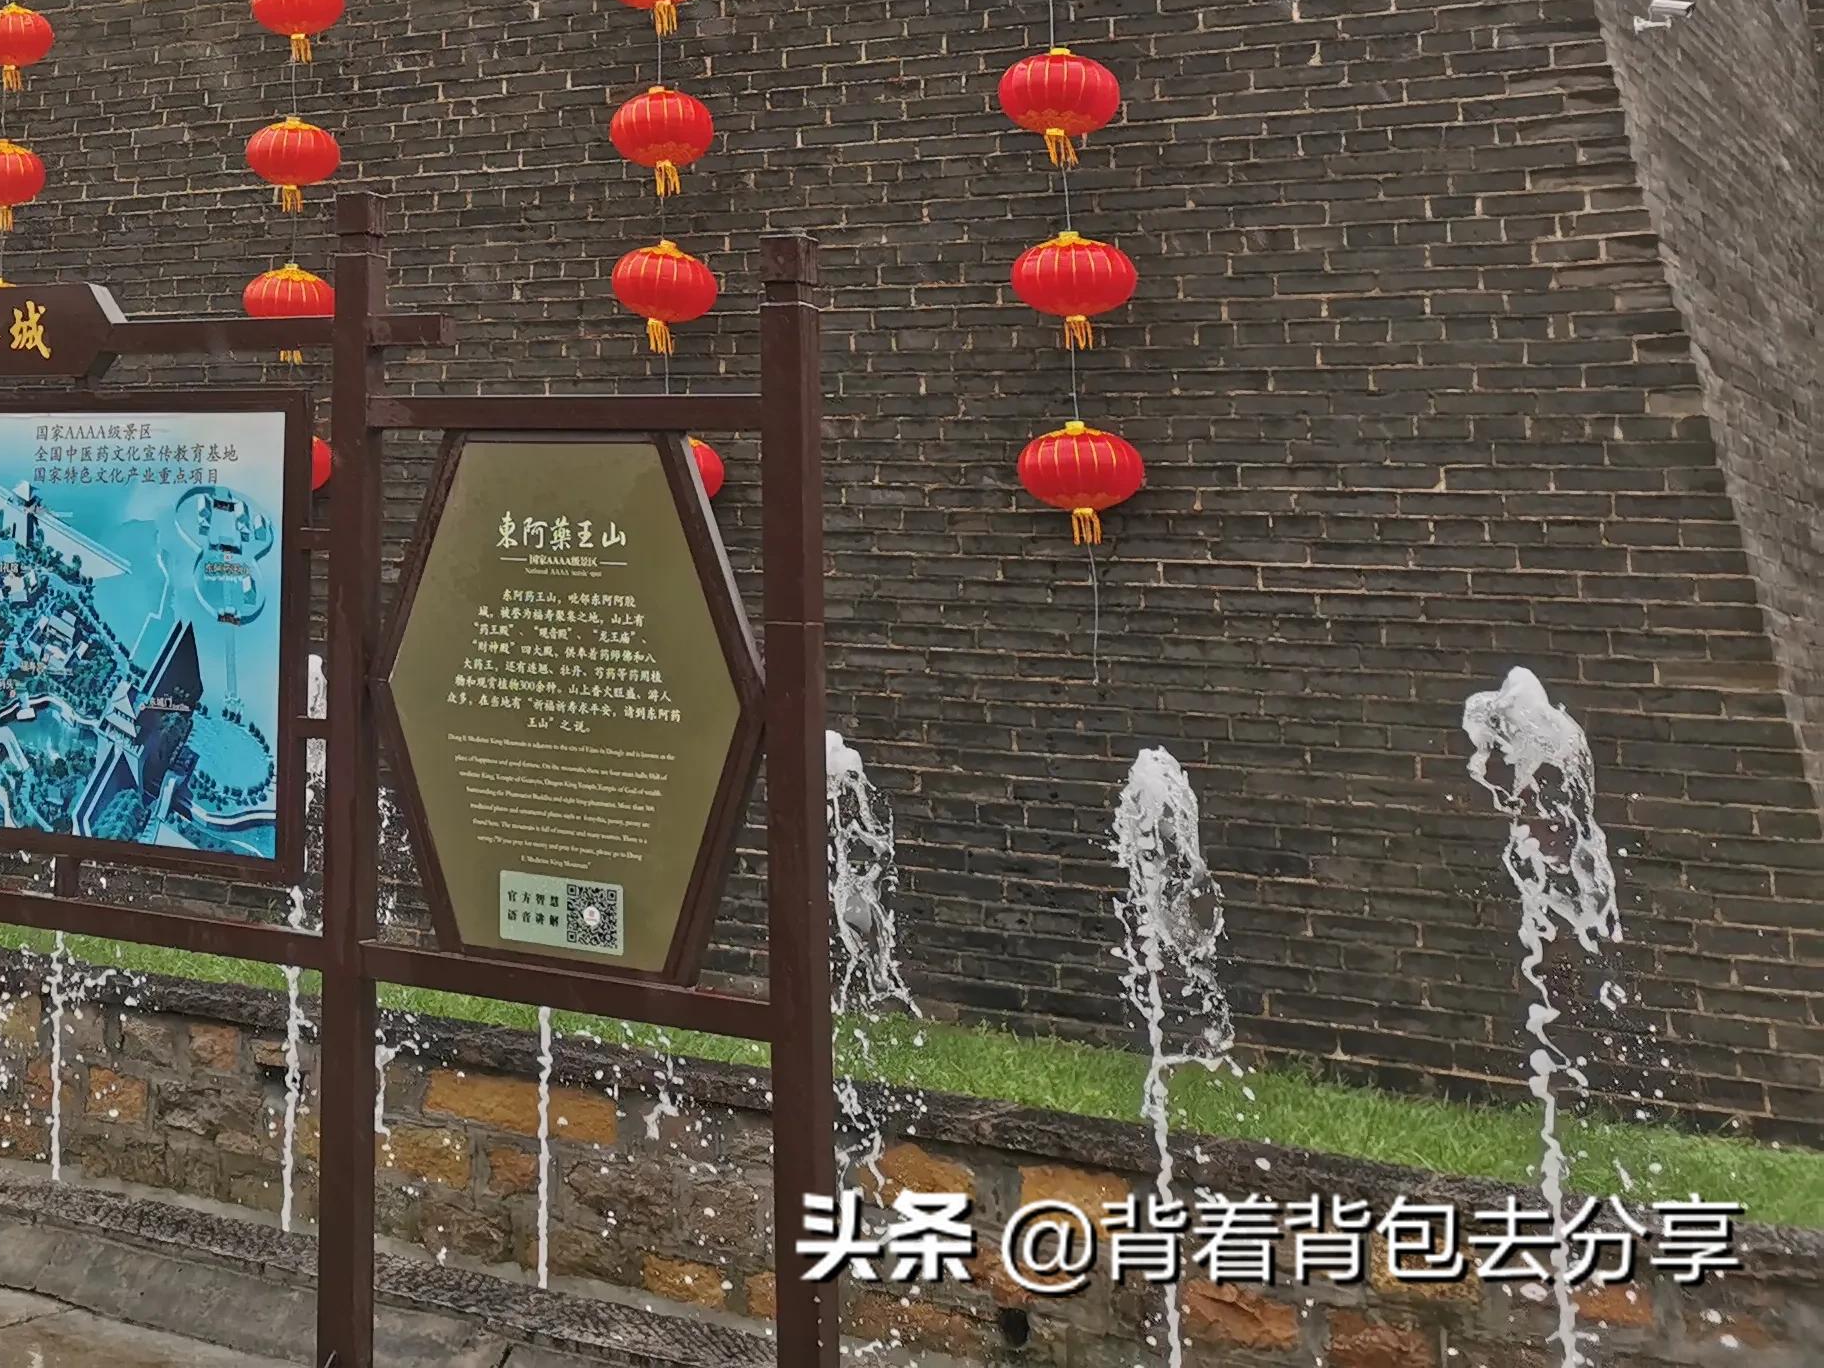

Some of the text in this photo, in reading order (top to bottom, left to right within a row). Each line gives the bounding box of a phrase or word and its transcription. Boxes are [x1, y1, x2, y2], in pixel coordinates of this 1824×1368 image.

[36, 423, 152, 442] 国家AAAA级景区
[34, 442, 239, 463] 全国中医药文化宣传教育基地
[33, 466, 219, 487] 国家特色文化产业重点项目
